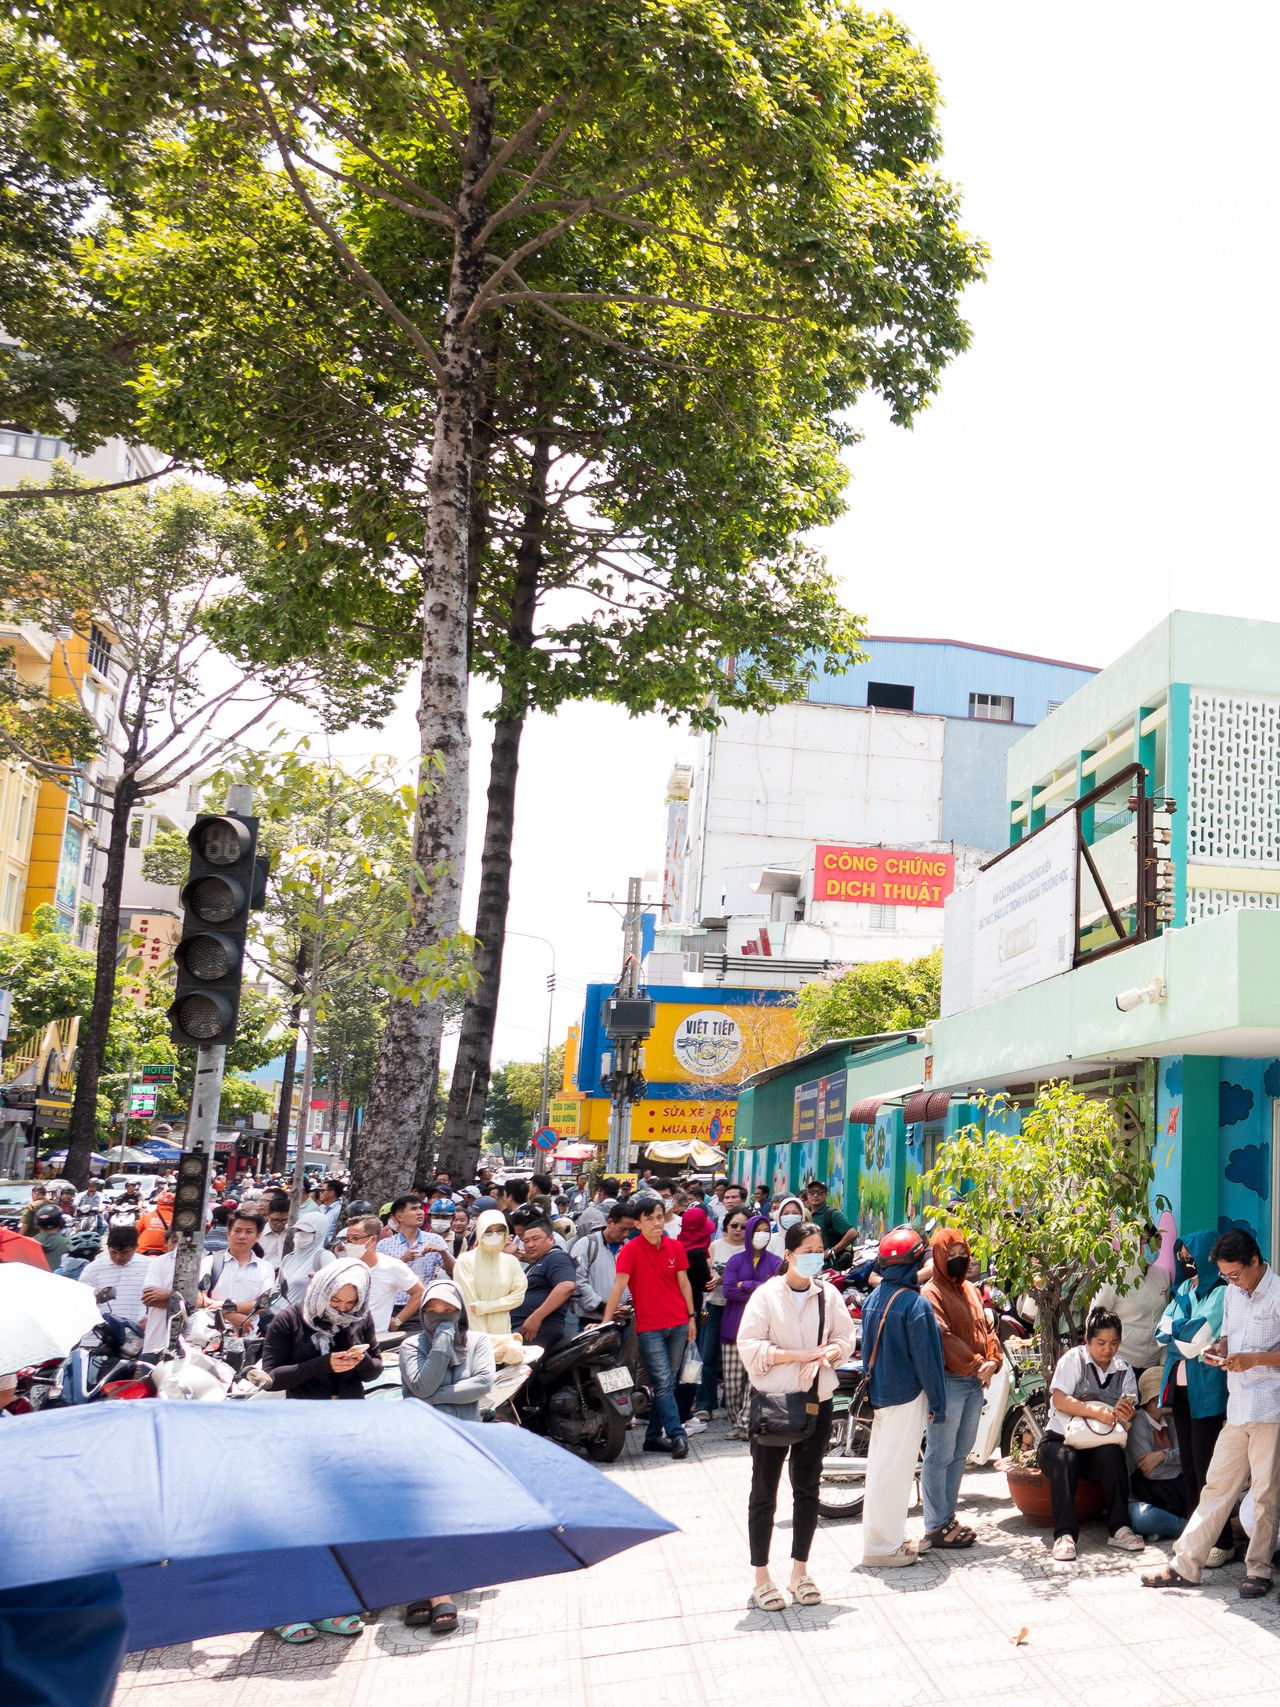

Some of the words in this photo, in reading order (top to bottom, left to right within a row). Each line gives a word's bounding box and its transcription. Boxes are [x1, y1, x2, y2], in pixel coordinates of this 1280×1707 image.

[823, 850, 879, 873] CÔNG
[884, 855, 947, 878] CHỨNG
[826, 879, 876, 900] DỊCH
[882, 880, 942, 905] THUẬT
[144, 1066, 173, 1074] HOTEL
[663, 1106, 686, 1117] SỬA
[689, 1108, 705, 1117] XE
[661, 1125, 687, 1134] MUA
